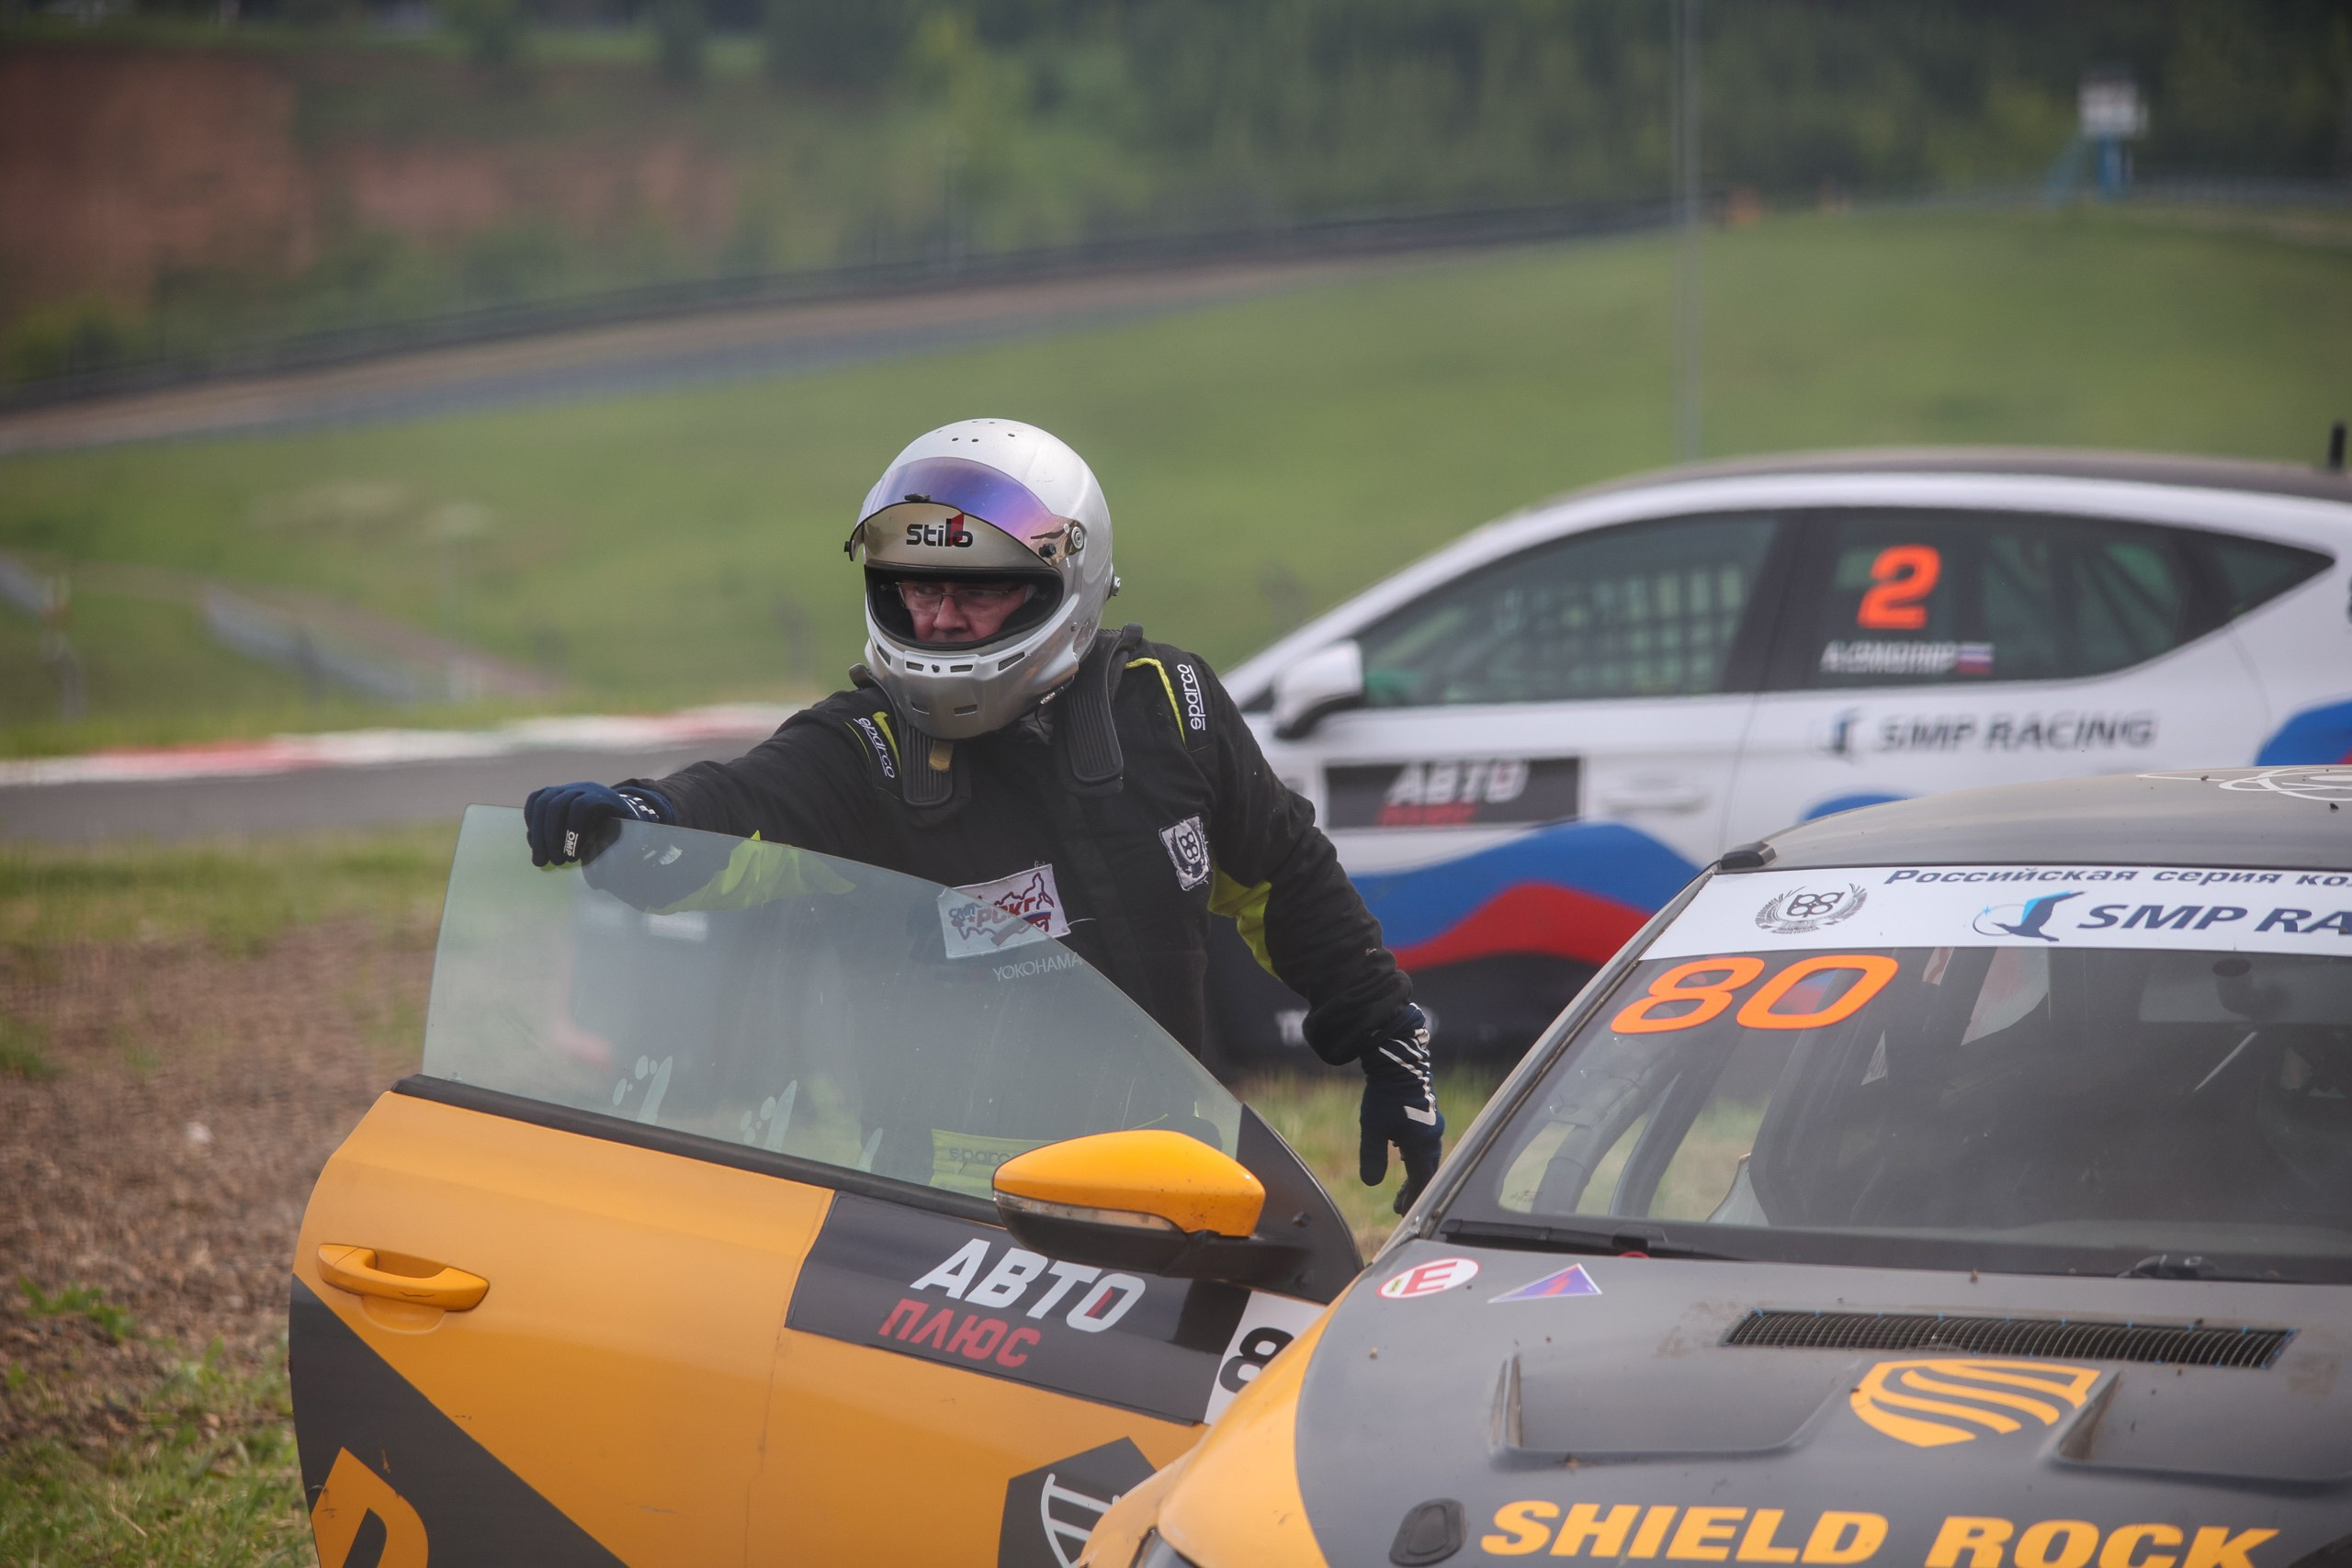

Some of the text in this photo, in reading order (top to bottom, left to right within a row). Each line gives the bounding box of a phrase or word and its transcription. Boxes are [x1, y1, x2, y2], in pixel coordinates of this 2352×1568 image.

[906, 513, 974, 548] Stilo
[1857, 544, 1941, 630] 2
[1177, 663, 1206, 731] sparco
[853, 717, 895, 778] sparco
[1877, 710, 2155, 751] SMP RACING
[564, 829, 579, 858] OMP
[1883, 867, 2352, 887] Российская серия ко
[2076, 904, 2248, 931] SMP
[992, 952, 1082, 982] YOKOHAMA
[1611, 954, 1899, 1034] 80
[910, 1237, 1146, 1334] АВТО
[878, 1298, 1042, 1368] ПЛЮС
[1480, 1499, 2281, 1568] SHIELD ROCK
